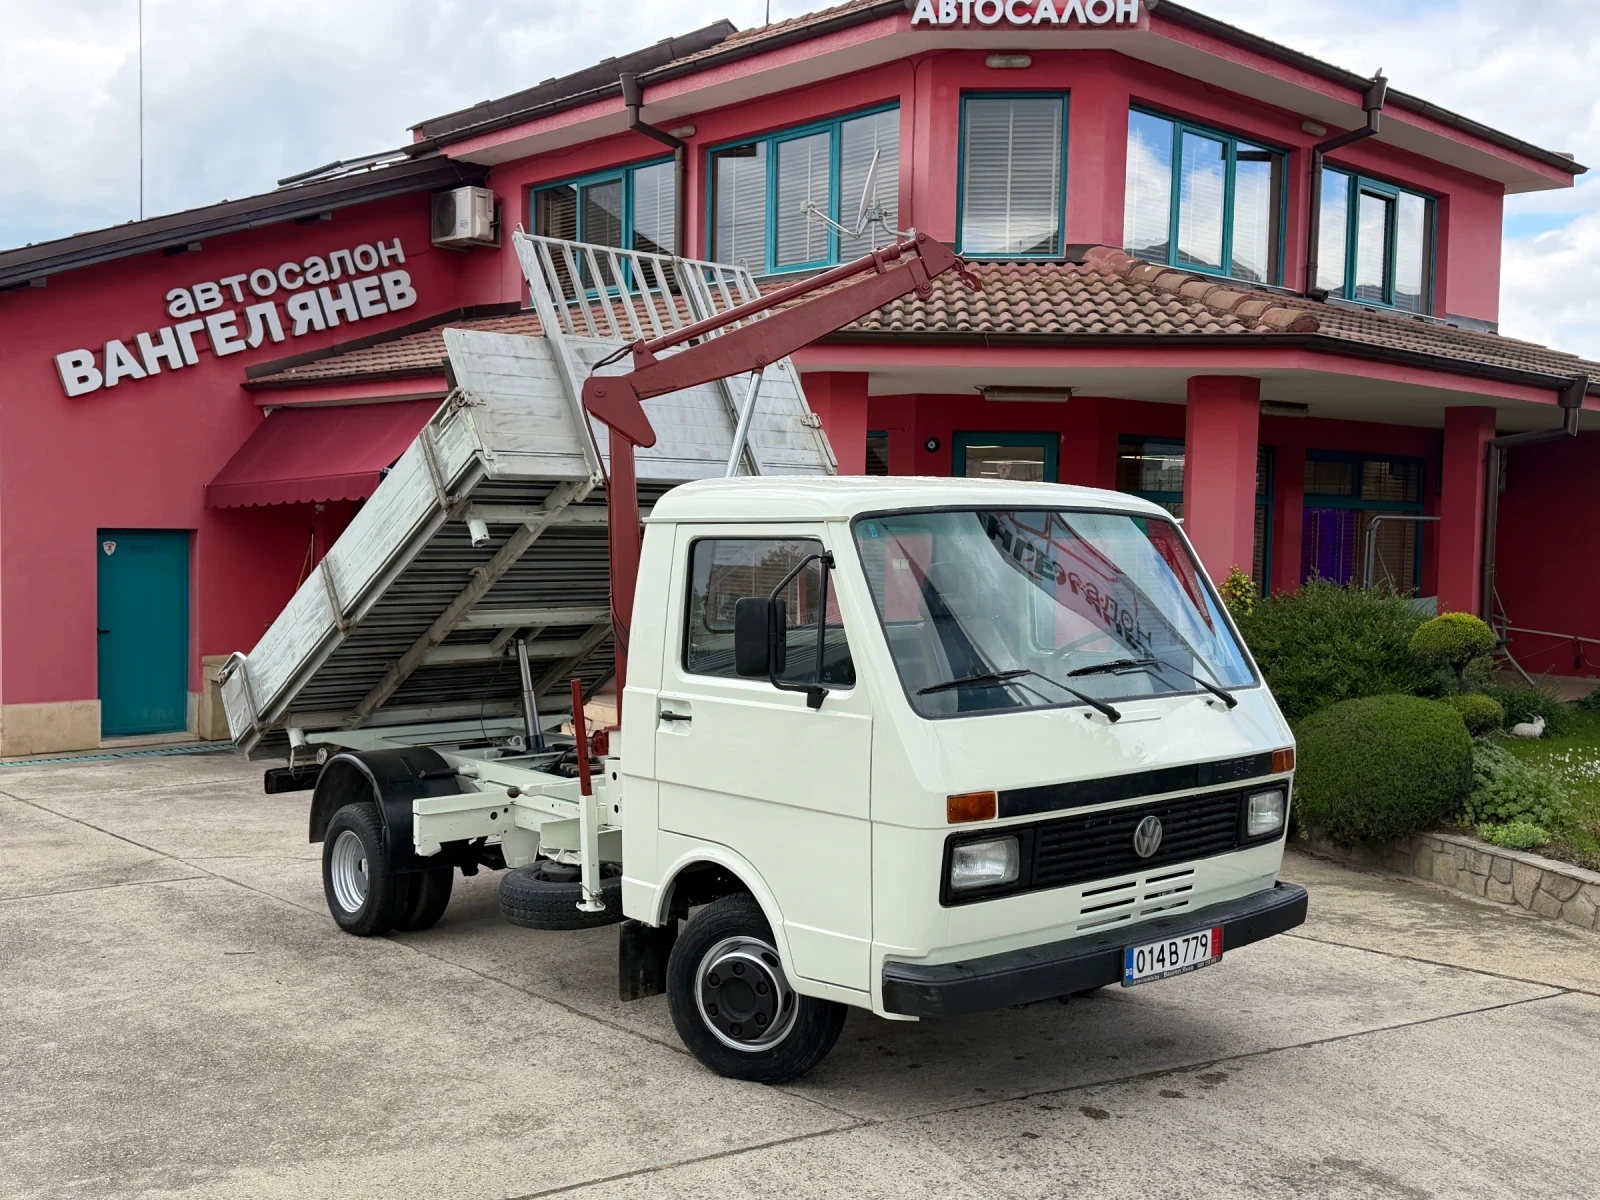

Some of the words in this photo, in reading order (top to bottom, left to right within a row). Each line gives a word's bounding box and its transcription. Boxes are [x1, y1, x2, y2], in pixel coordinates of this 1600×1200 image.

[911, 0, 1139, 25] АВТОСАЛОН
[165, 237, 406, 318] автосалон
[53, 301, 285, 397] ВАНГЕЛ
[285, 269, 417, 337] ЯНЕВ
[1136, 934, 1208, 973] 014B779
